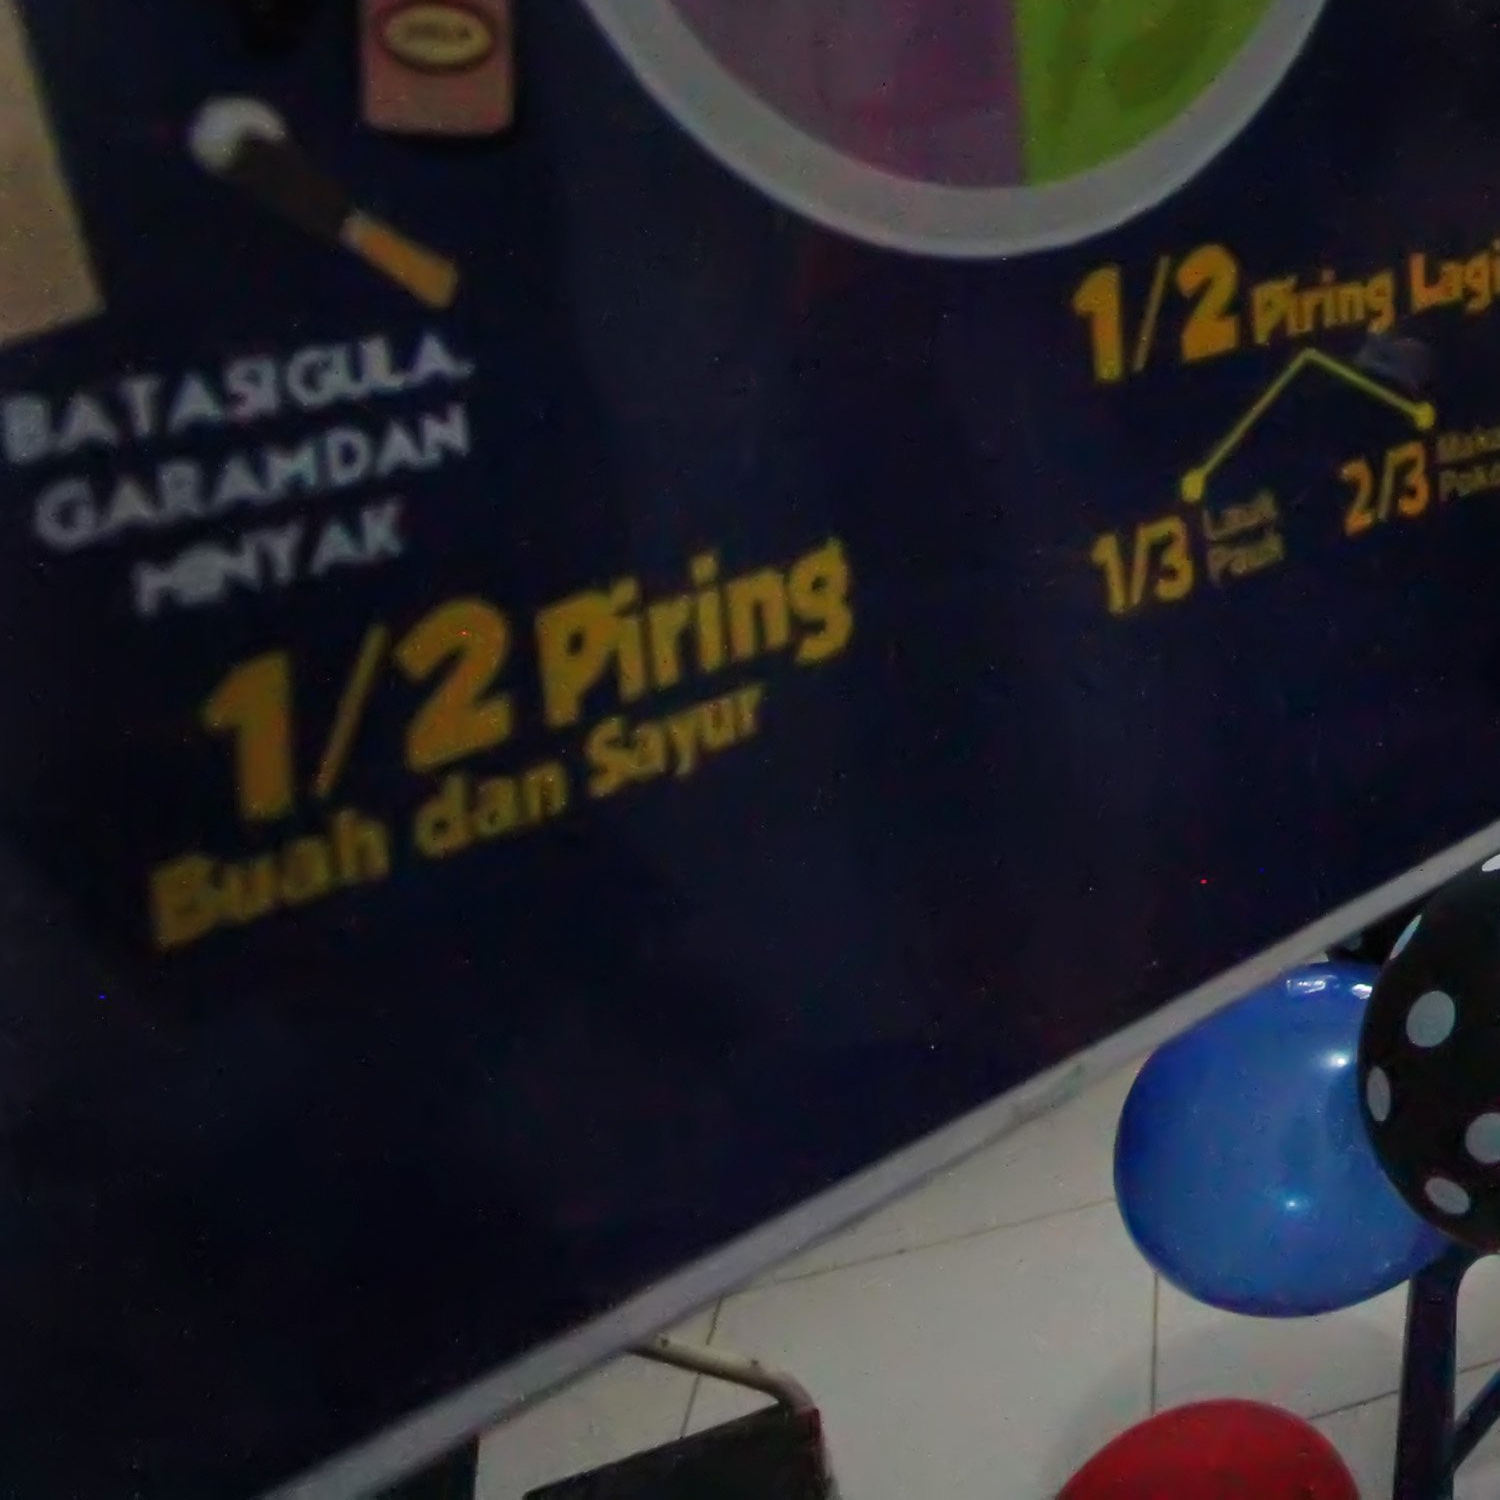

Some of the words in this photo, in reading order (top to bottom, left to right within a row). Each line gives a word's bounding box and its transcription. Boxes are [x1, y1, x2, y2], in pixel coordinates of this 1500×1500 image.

[1072, 244, 1240, 384] 1/2
[1251, 268, 1397, 346] Piring
[1339, 441, 1431, 537] 2/3
[1092, 515, 1195, 616] 1/3
[204, 596, 513, 821] 1/2
[534, 536, 855, 729] Piring
[150, 808, 391, 951] Buah
[412, 760, 568, 858] dan
[585, 686, 765, 799] Sayur
